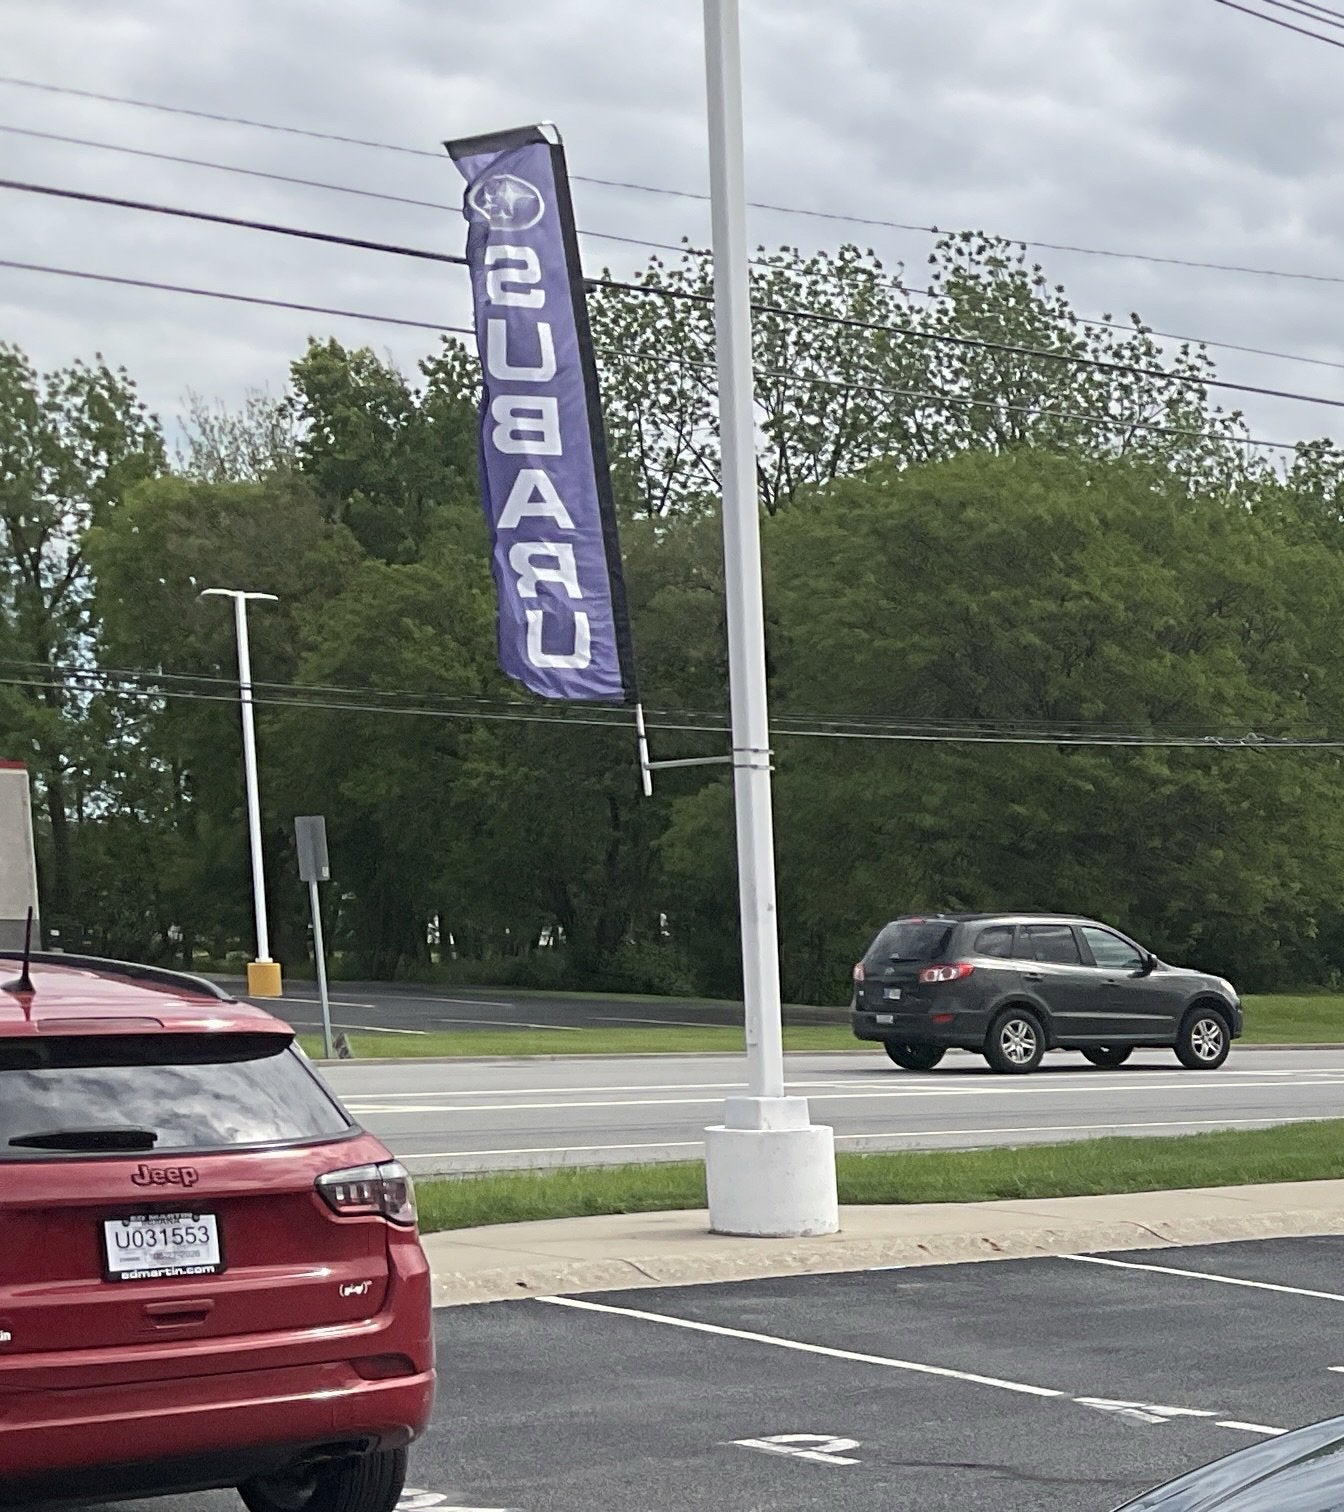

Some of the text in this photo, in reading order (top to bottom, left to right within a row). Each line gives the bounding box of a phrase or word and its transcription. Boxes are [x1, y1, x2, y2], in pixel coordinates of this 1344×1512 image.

[131, 1164, 199, 1187] Jeep
[115, 1225, 210, 1249] U031553
[121, 1265, 215, 1280] edmartin.com
